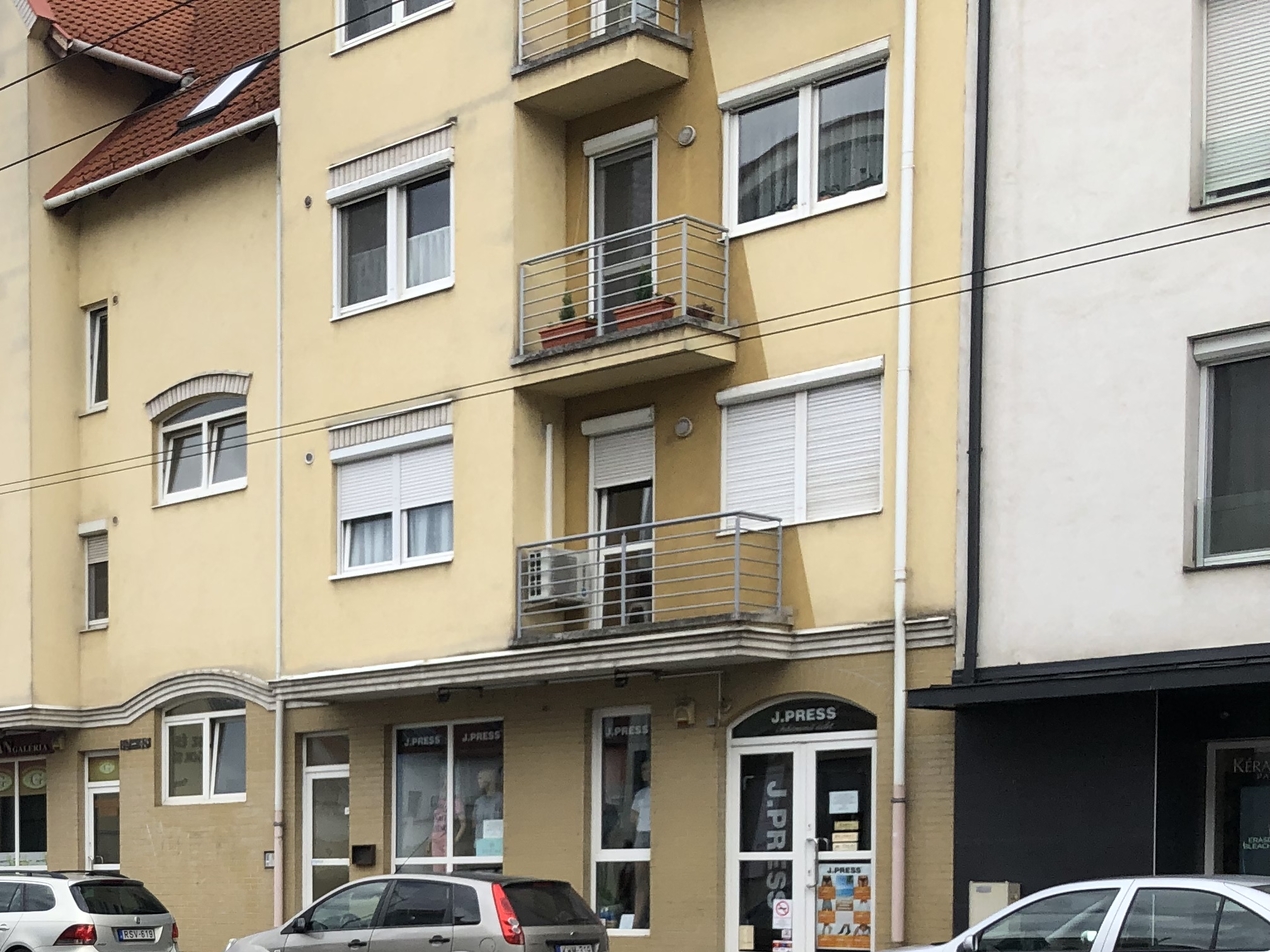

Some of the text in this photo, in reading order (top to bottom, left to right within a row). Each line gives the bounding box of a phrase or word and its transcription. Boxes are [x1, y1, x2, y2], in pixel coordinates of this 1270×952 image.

[771, 706, 837, 724] J.PRESS
[462, 731, 501, 743] J.PRESS
[605, 725, 649, 737] J.PRESS
[404, 735, 441, 747] J.PRESS
[766, 781, 787, 910] J.PRESS
[123, 930, 153, 939] RSV-619
